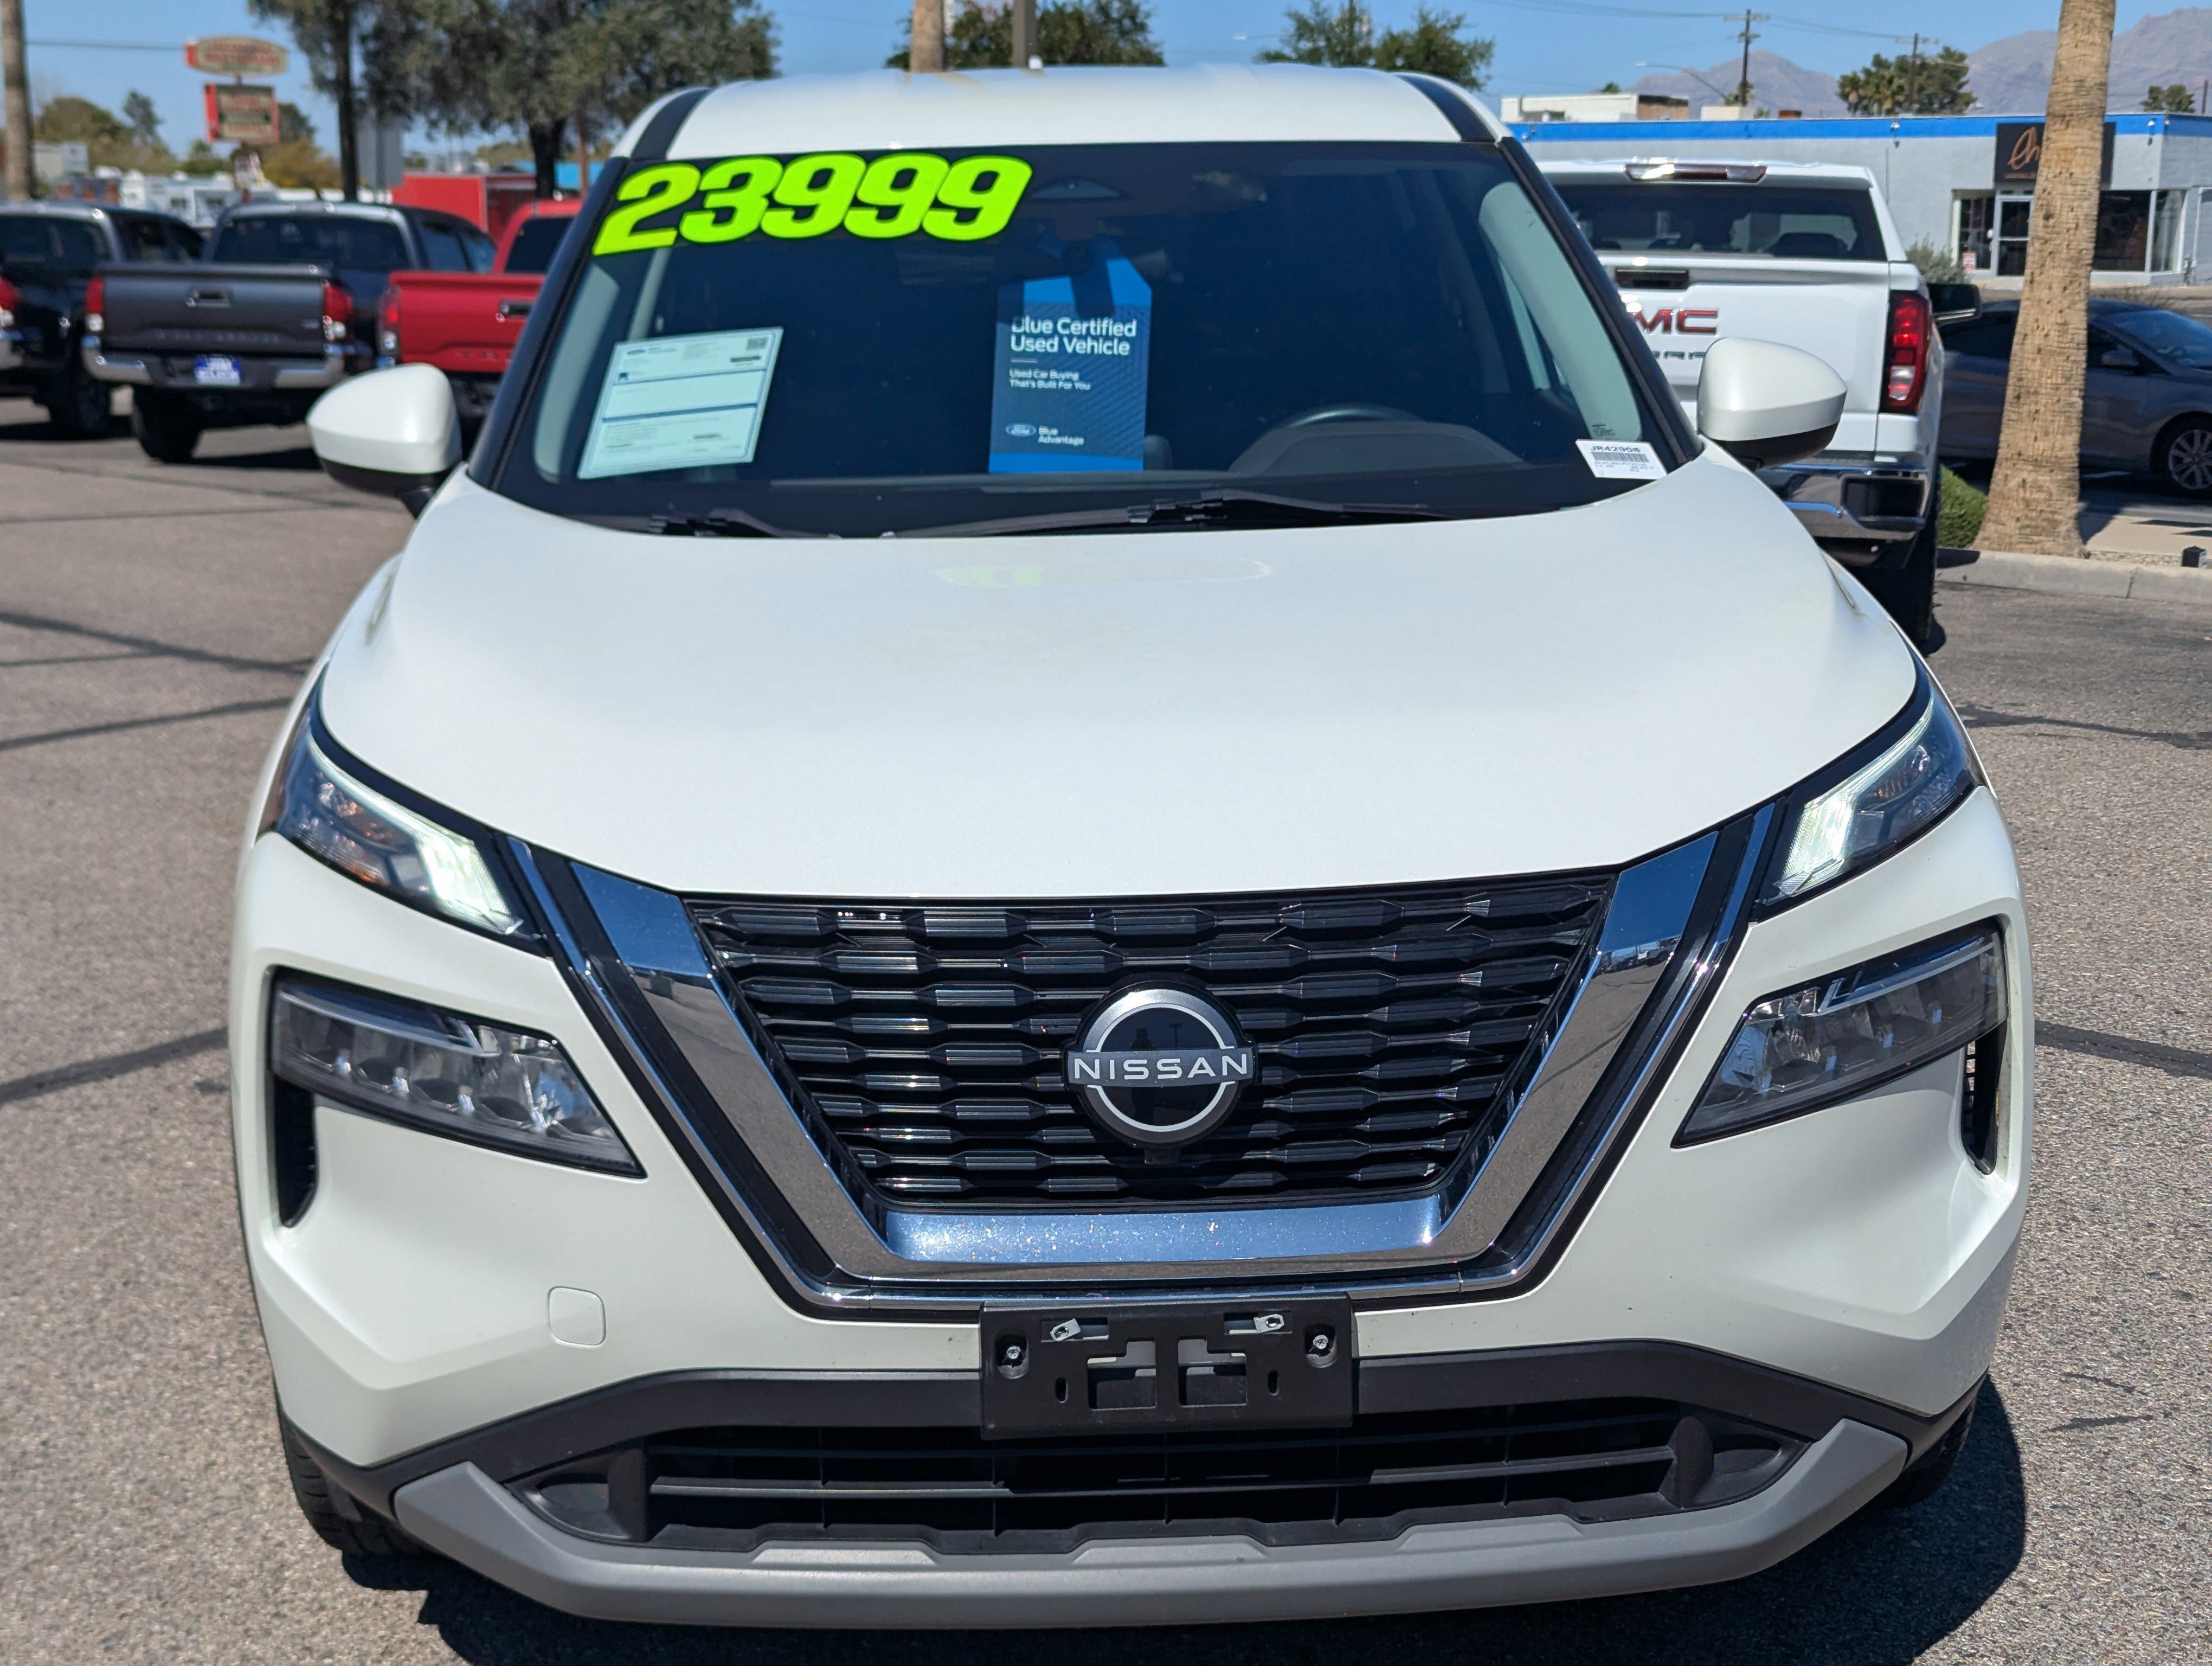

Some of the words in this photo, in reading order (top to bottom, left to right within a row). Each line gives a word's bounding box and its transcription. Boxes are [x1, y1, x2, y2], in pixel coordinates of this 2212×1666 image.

[593, 152, 1033, 255] 23999
[1011, 315, 1053, 334] Blue
[1057, 316, 1137, 337] Certified
[1628, 308, 1719, 335] MC
[1011, 334, 1059, 353] Used
[1063, 335, 1130, 356] Vehicle
[1009, 368, 1032, 379] Used
[1033, 369, 1049, 379] Car
[1049, 369, 1080, 382] Buying
[1009, 379, 1036, 388] That's
[1037, 380, 1057, 389] Built
[1058, 381, 1073, 390] For
[1073, 381, 1092, 391] You
[1038, 425, 1058, 435] Blue
[1038, 434, 1085, 446] Advantage
[1074, 1054, 1248, 1080] NISSAN
